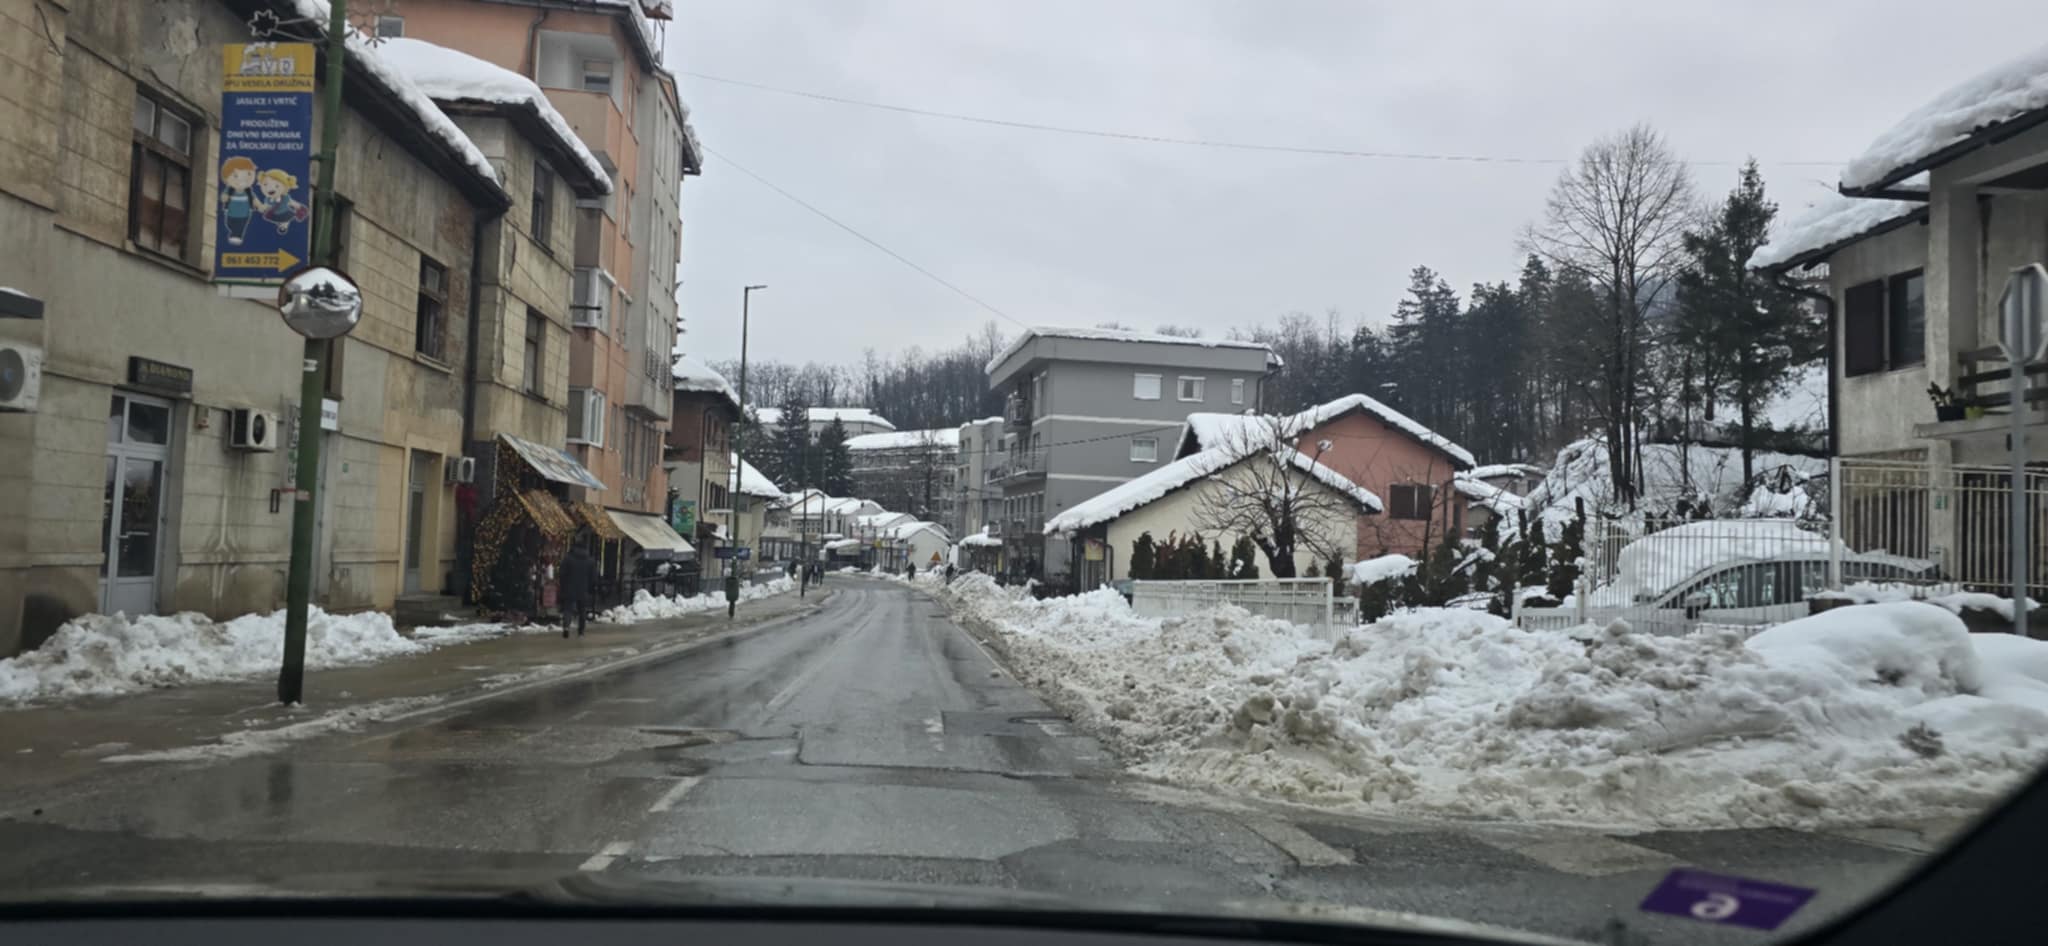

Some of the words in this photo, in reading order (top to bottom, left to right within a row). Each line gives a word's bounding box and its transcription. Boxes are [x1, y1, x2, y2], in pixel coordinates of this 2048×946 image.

[242, 79, 271, 87] VESELA
[274, 78, 311, 87] DRUŽINA
[236, 97, 266, 105] JASLICE
[240, 119, 289, 127] PRODUŽENI
[226, 142, 237, 150] ZA
[239, 140, 275, 150] ŠKOLSKU
[277, 142, 304, 150] DJECU
[226, 256, 242, 264] 061
